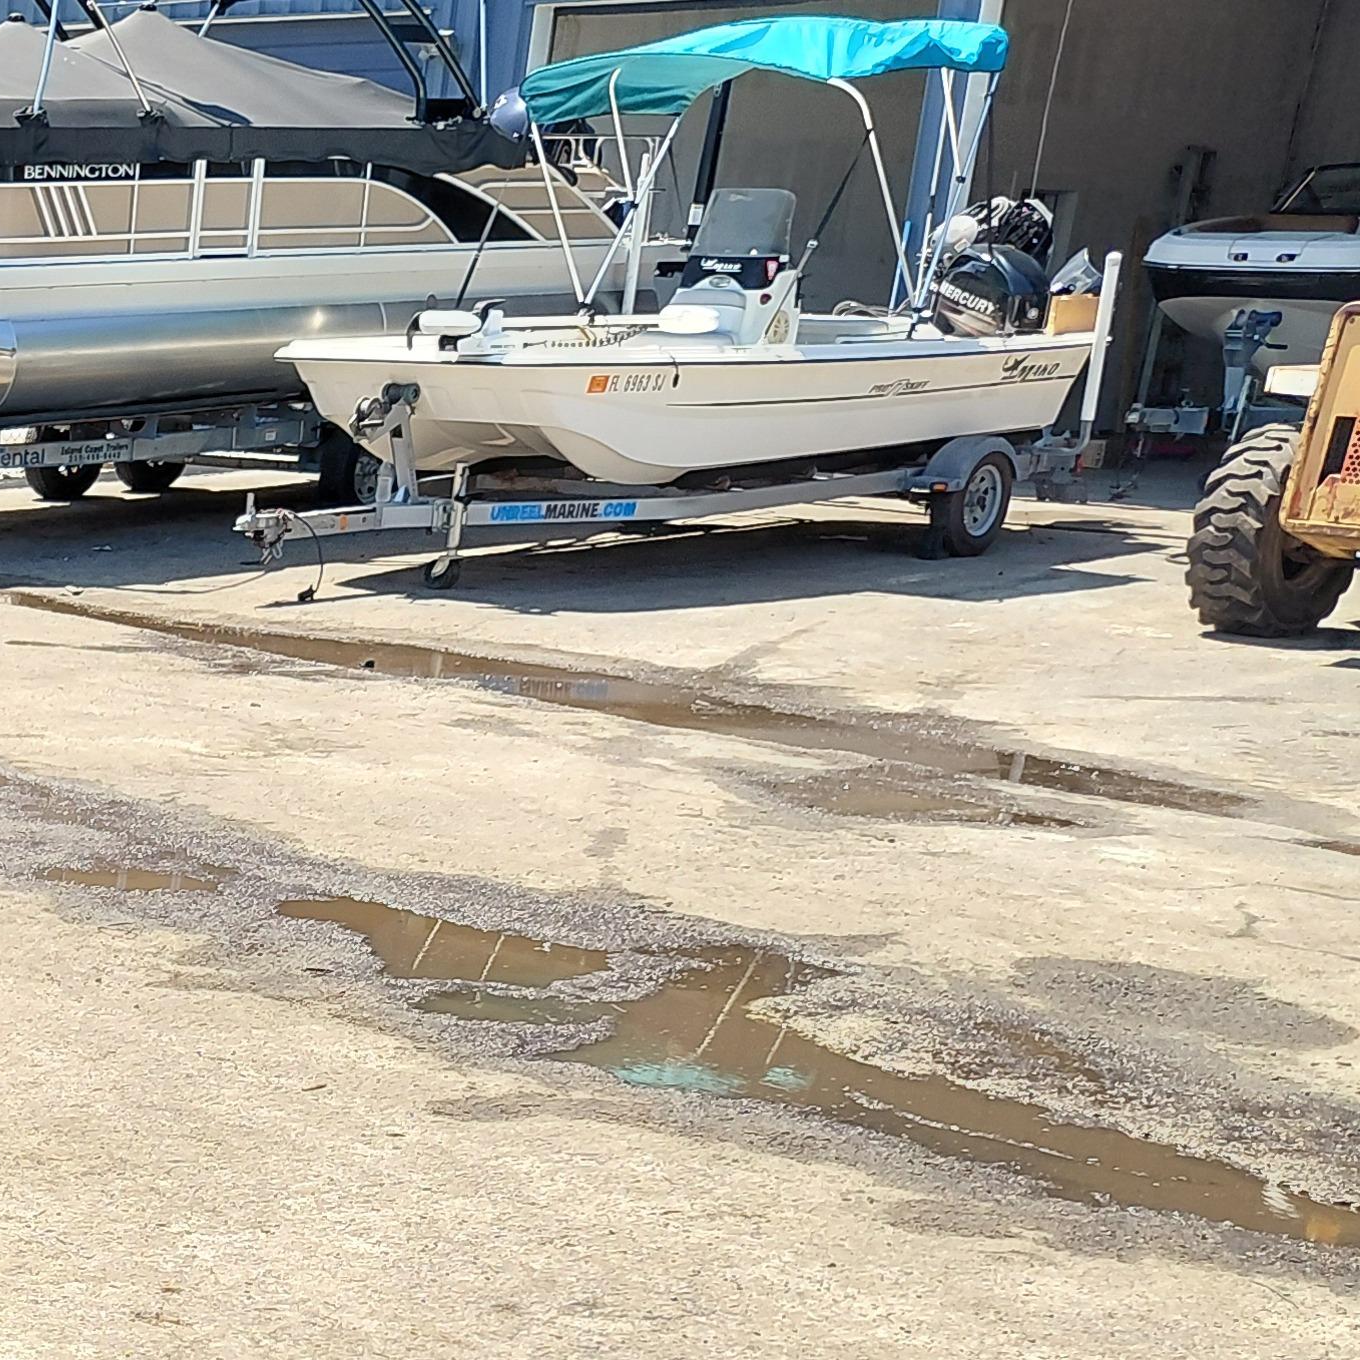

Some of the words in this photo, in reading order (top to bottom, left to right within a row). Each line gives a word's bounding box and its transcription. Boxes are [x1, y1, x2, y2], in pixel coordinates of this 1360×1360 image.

[24, 164, 135, 180] BENNINGTON
[939, 280, 996, 316] MERCURY
[608, 374, 620, 392] FL
[623, 374, 651, 393] 6963
[652, 373, 667, 392] SJ
